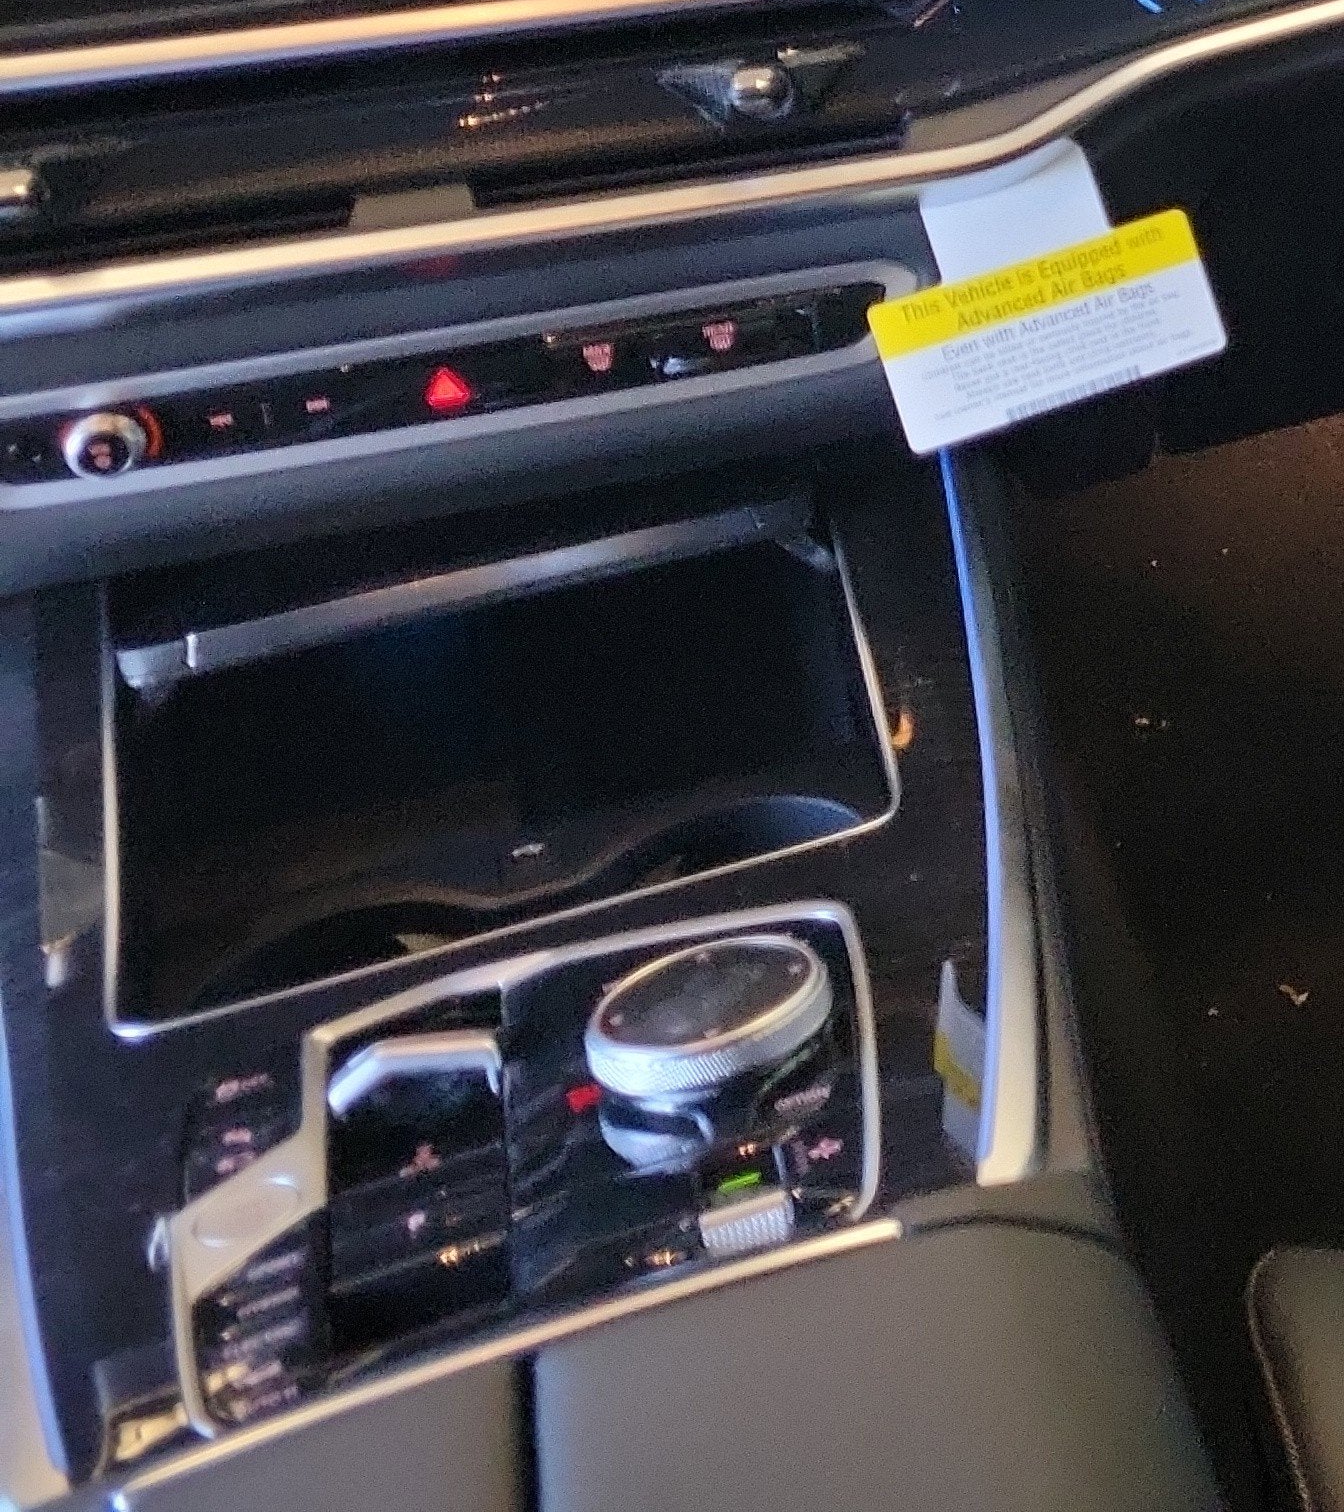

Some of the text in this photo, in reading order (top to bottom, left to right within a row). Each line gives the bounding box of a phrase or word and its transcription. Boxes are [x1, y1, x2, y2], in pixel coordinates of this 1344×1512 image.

[901, 225, 1163, 325] This Vehicle is Equipped with
[955, 261, 1128, 332] Advanced Air Bags
